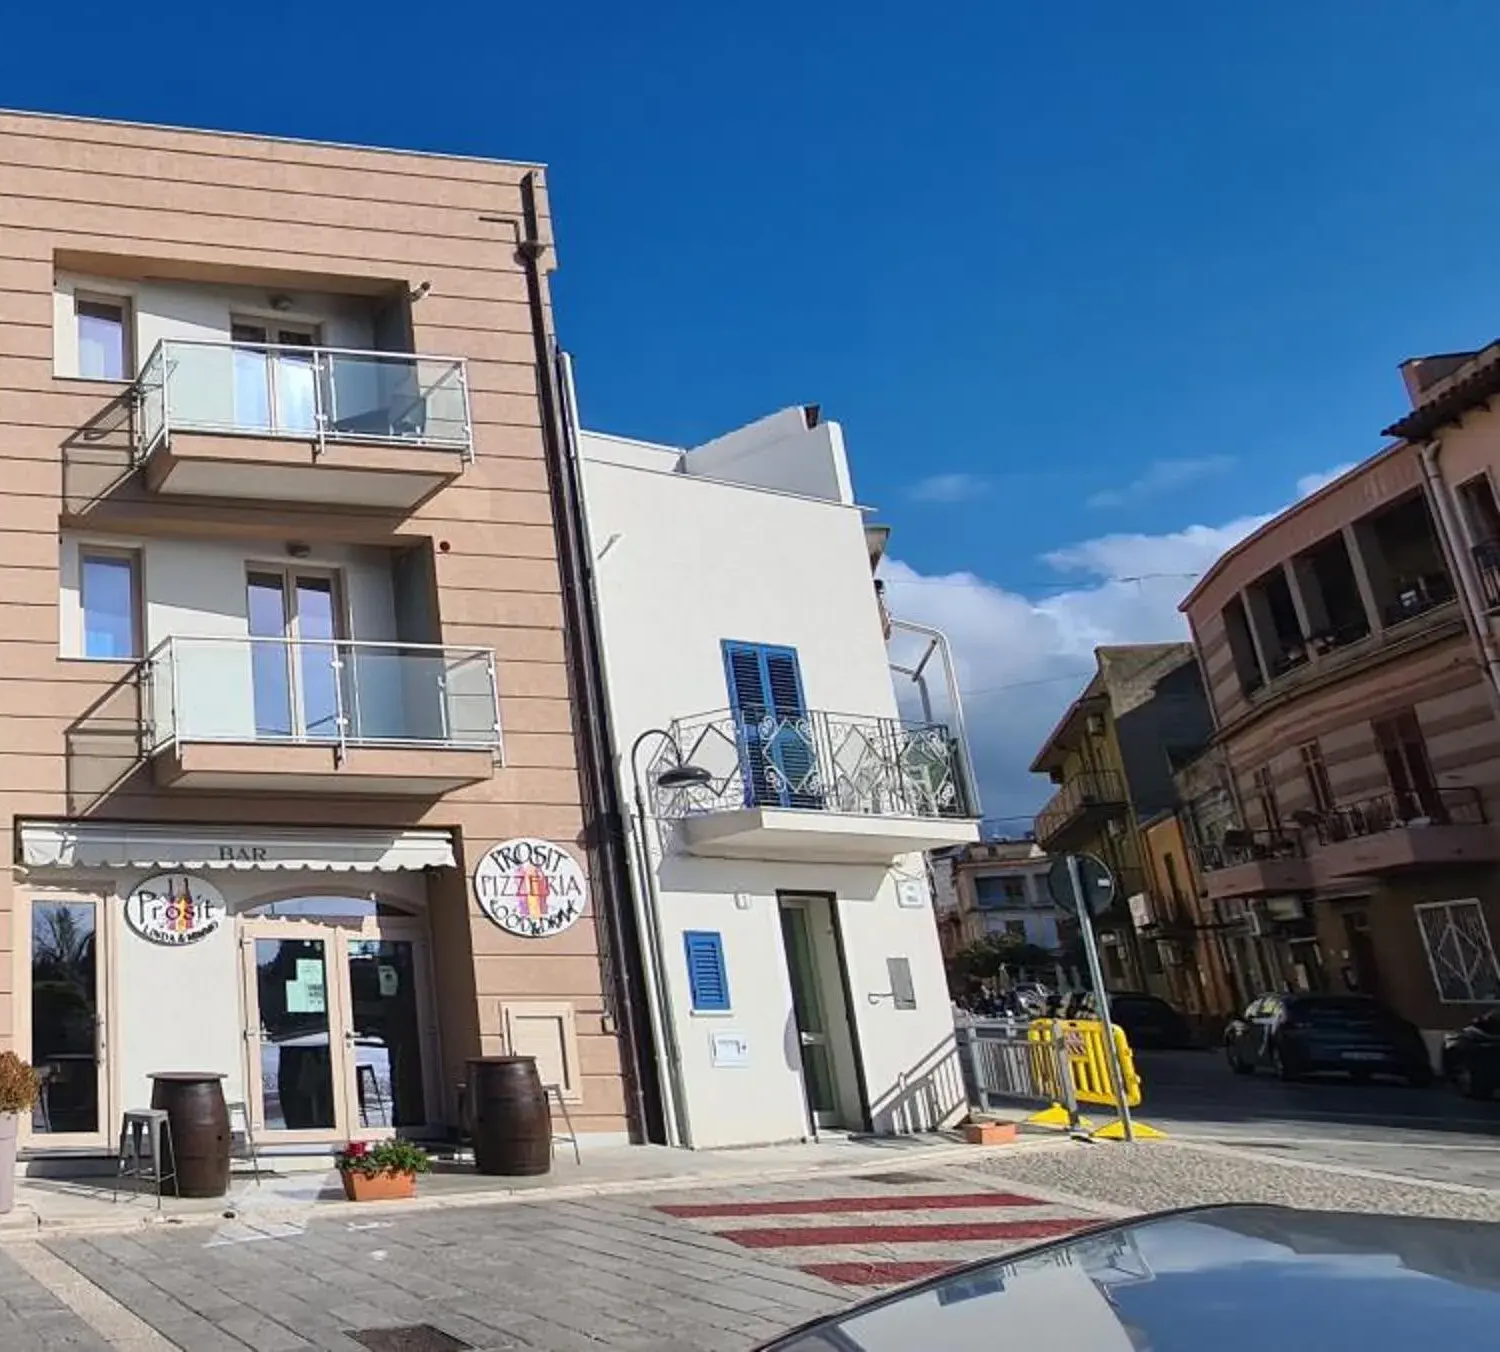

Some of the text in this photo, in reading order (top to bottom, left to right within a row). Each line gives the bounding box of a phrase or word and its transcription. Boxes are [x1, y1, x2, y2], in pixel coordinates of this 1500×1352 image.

[219, 846, 267, 861] BAR
[490, 842, 569, 873] PROSIT
[481, 874, 581, 897] PIZZERIA
[138, 889, 214, 924] Prosit
